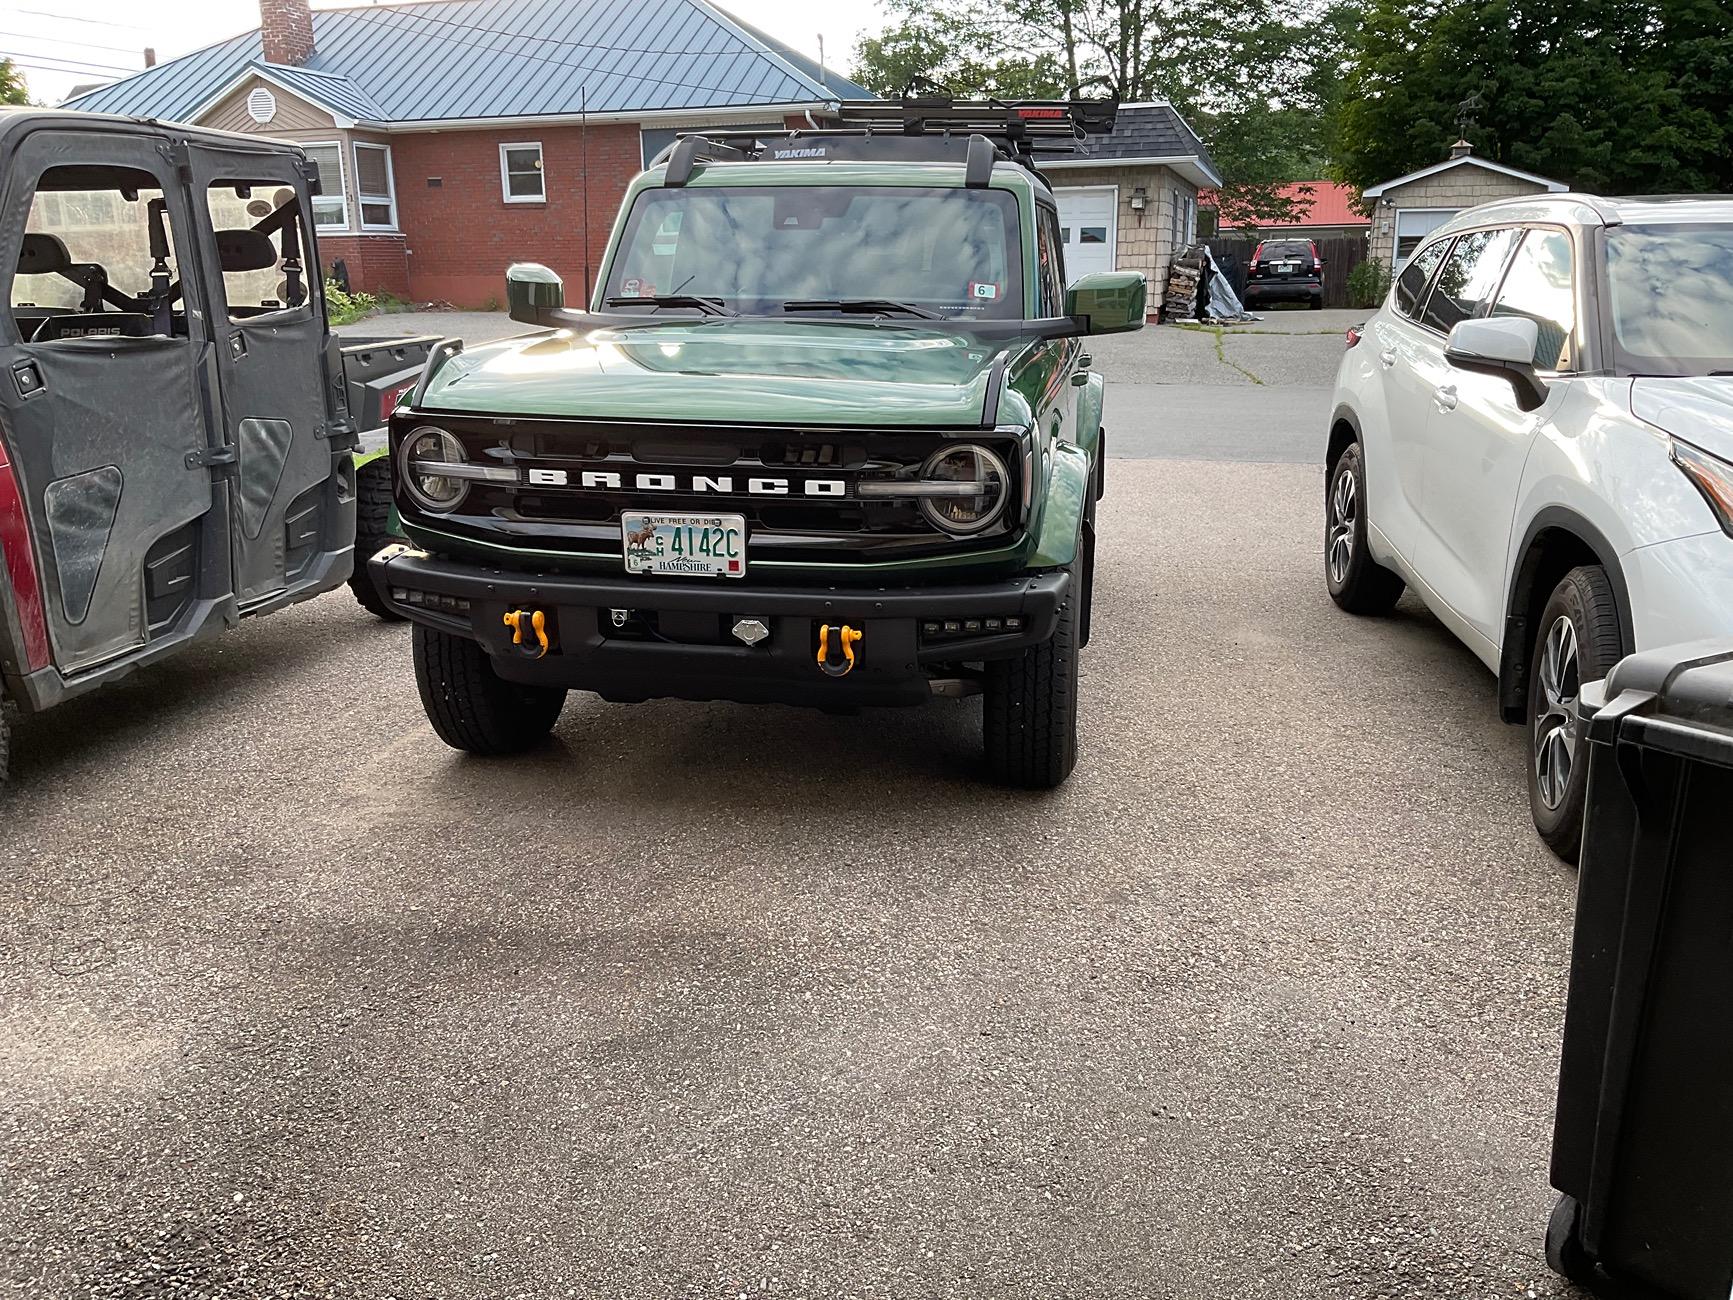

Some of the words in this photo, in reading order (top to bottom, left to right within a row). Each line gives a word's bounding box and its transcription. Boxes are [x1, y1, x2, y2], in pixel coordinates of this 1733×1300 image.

[1018, 108, 1062, 118] YAKIMA
[774, 147, 826, 160] YAKIMA
[978, 286, 985, 296] 6
[61, 327, 120, 337] POLARIS
[528, 468, 846, 496] BRONCO
[671, 526, 739, 558] 4142C
[659, 561, 712, 572] HAMPSHIRE
